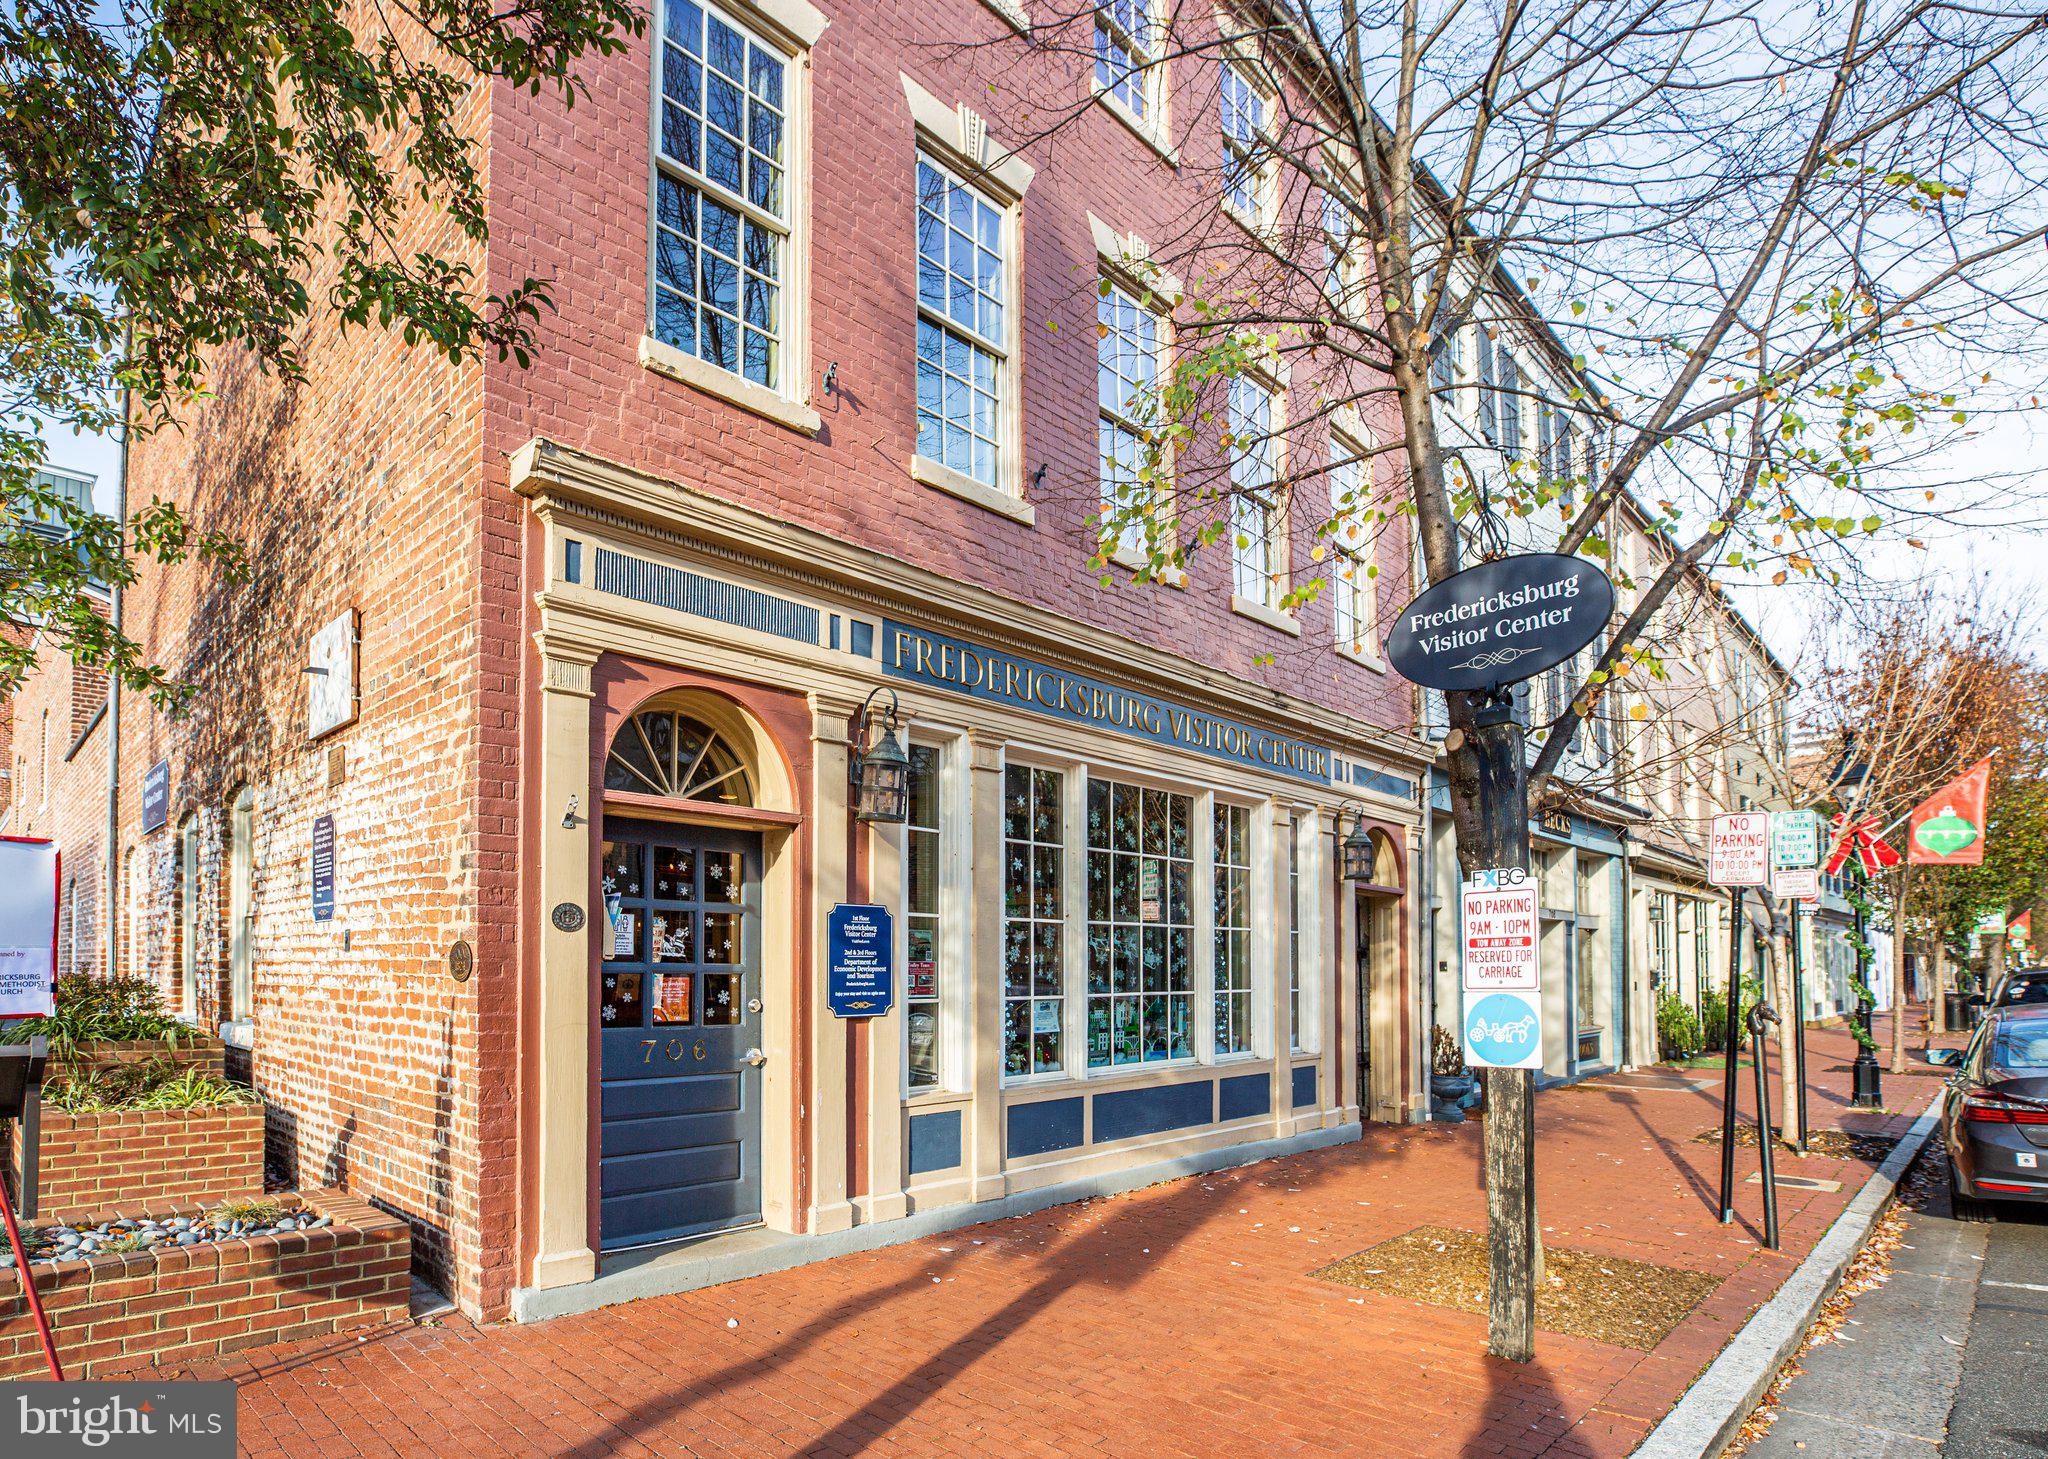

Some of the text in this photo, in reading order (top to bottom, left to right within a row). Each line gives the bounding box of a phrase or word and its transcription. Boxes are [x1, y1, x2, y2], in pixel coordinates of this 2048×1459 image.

[1410, 574, 1580, 633] Fredericksburg
[1418, 605, 1574, 656] Visitor Center
[894, 631, 1327, 778] FREDERICKSBURG VISITOR CENTER
[1730, 818, 1749, 831] NO
[1715, 834, 1764, 848] PARKING
[1722, 850, 1756, 858] 9:00 AM
[1714, 860, 1763, 870] TO 10:00 PM
[1472, 868, 1525, 888] FXBG
[1468, 898, 1531, 916] NO PARKING
[843, 924, 877, 932] Fredericksburg
[1470, 921, 1491, 936] 9AM
[1503, 919, 1530, 934] 10PM
[1490, 938, 1506, 947] AWAY
[1469, 949, 1532, 963] RESERVED FOR
[1479, 966, 1522, 978] CARRIAGE
[640, 1038, 707, 1064] 706
